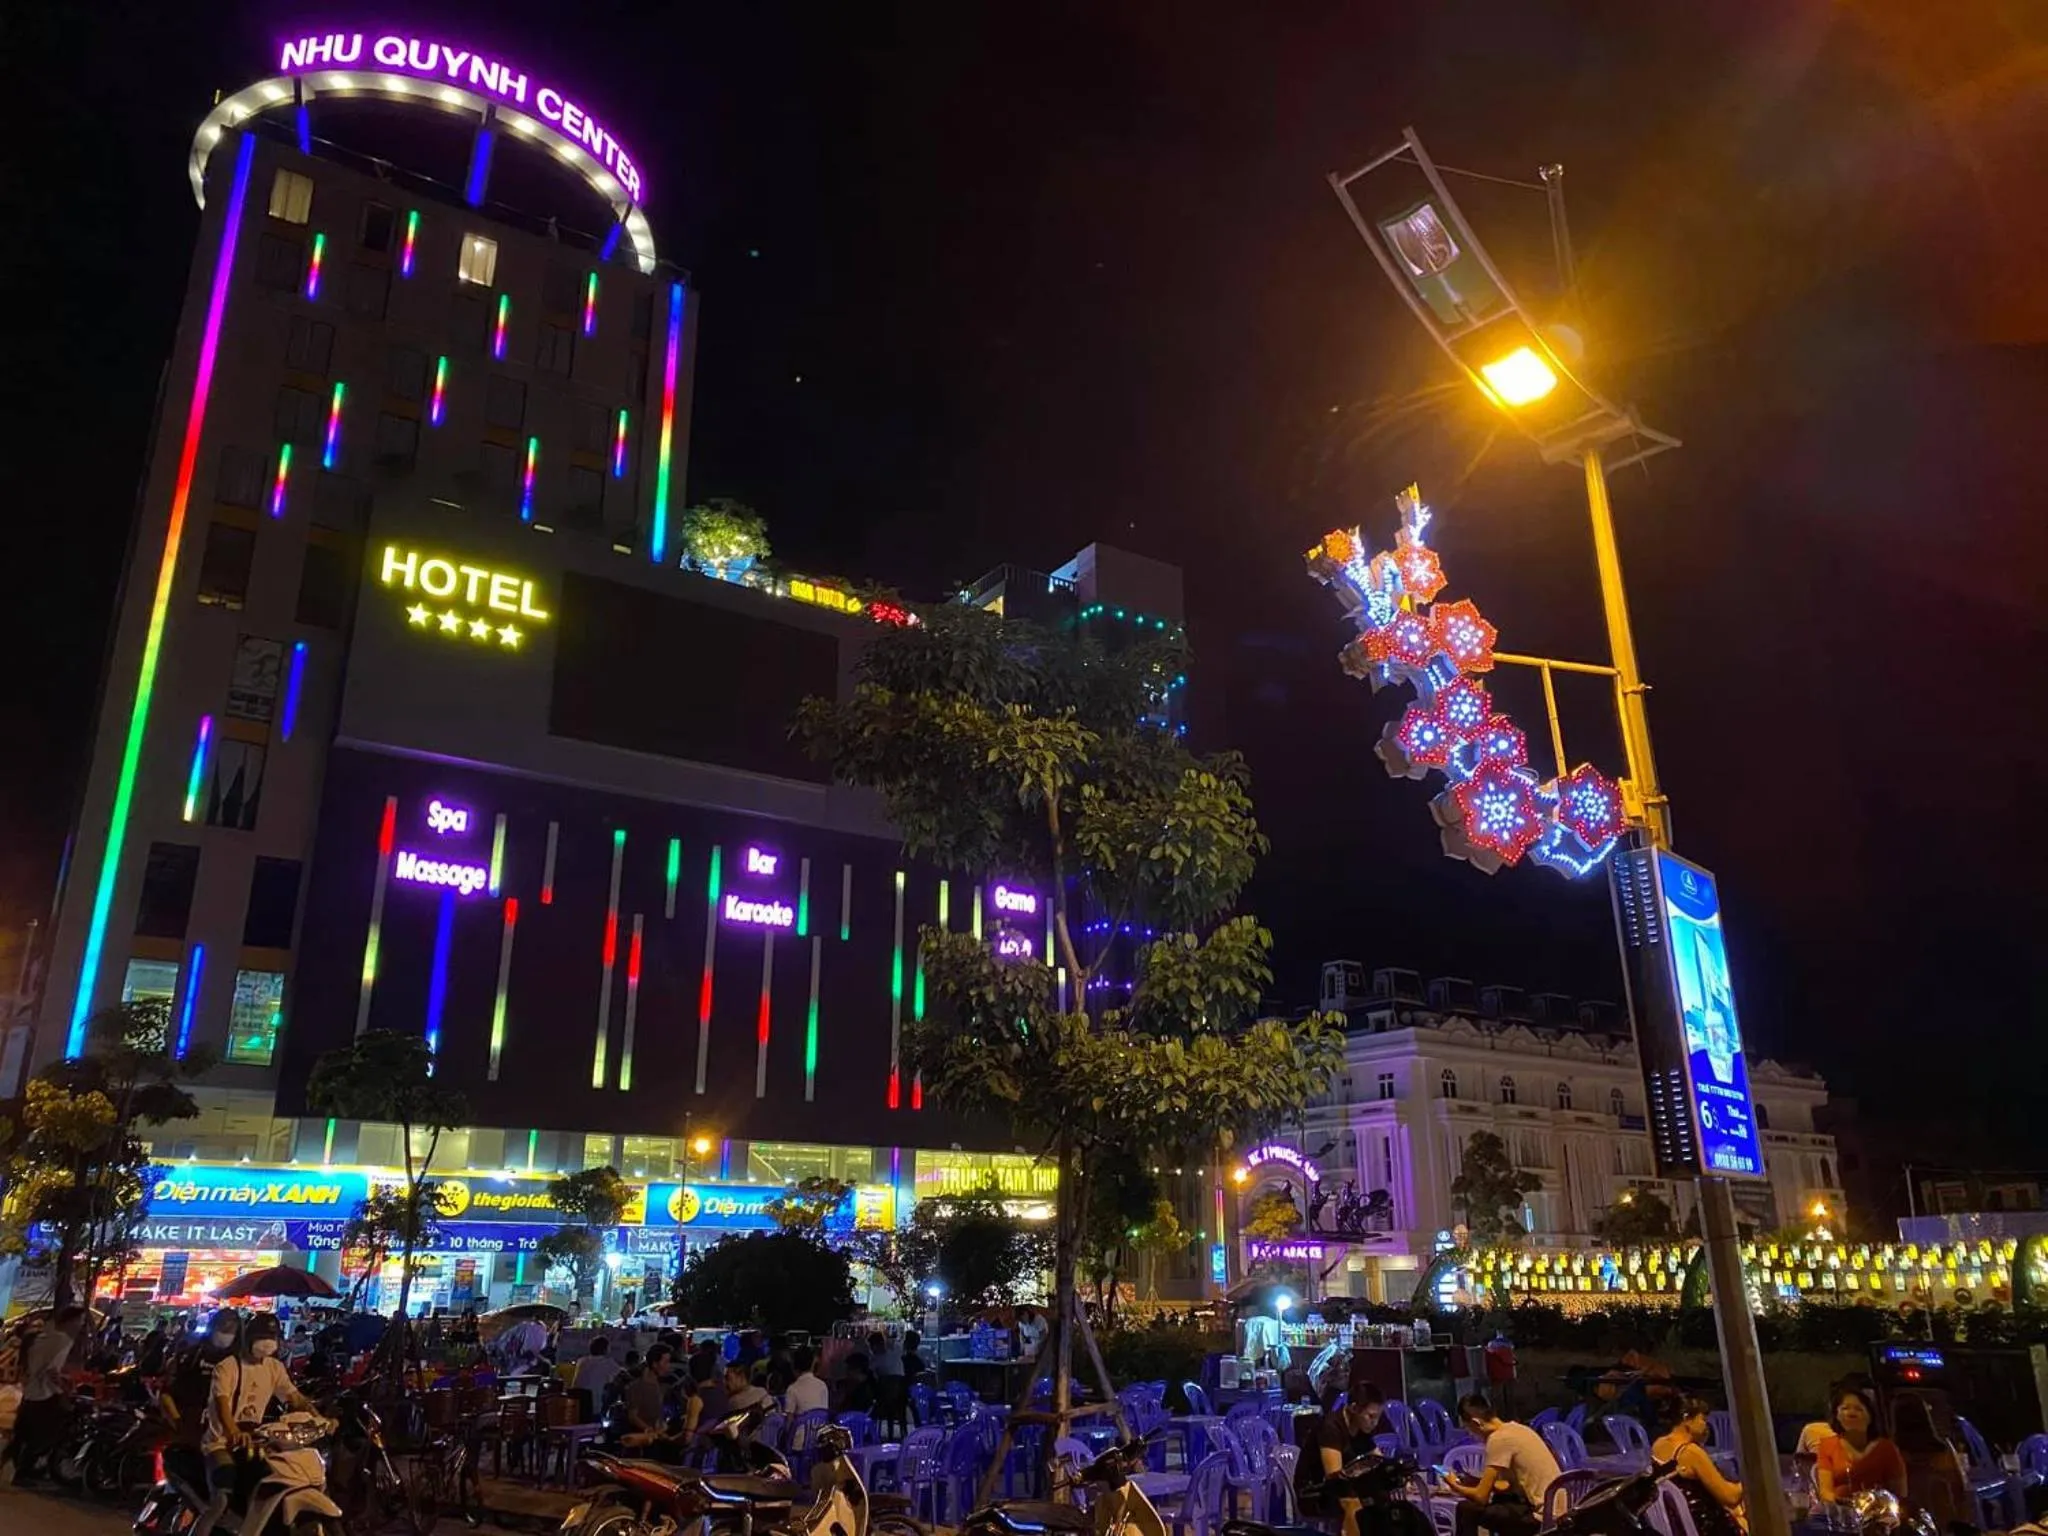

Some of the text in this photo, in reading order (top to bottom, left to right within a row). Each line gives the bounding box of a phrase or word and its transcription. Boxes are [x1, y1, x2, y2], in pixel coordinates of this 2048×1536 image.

[280, 33, 641, 201] NHU QUYNH CENTER
[381, 546, 550, 619] HOTEL
[427, 800, 467, 833] Spa
[396, 851, 486, 895] Massage
[748, 847, 777, 875] Bar
[725, 894, 793, 926] Karaoke
[187, 1226, 204, 1240] IT
[210, 1227, 257, 1240] LAST
[450, 1237, 463, 1249] 10
